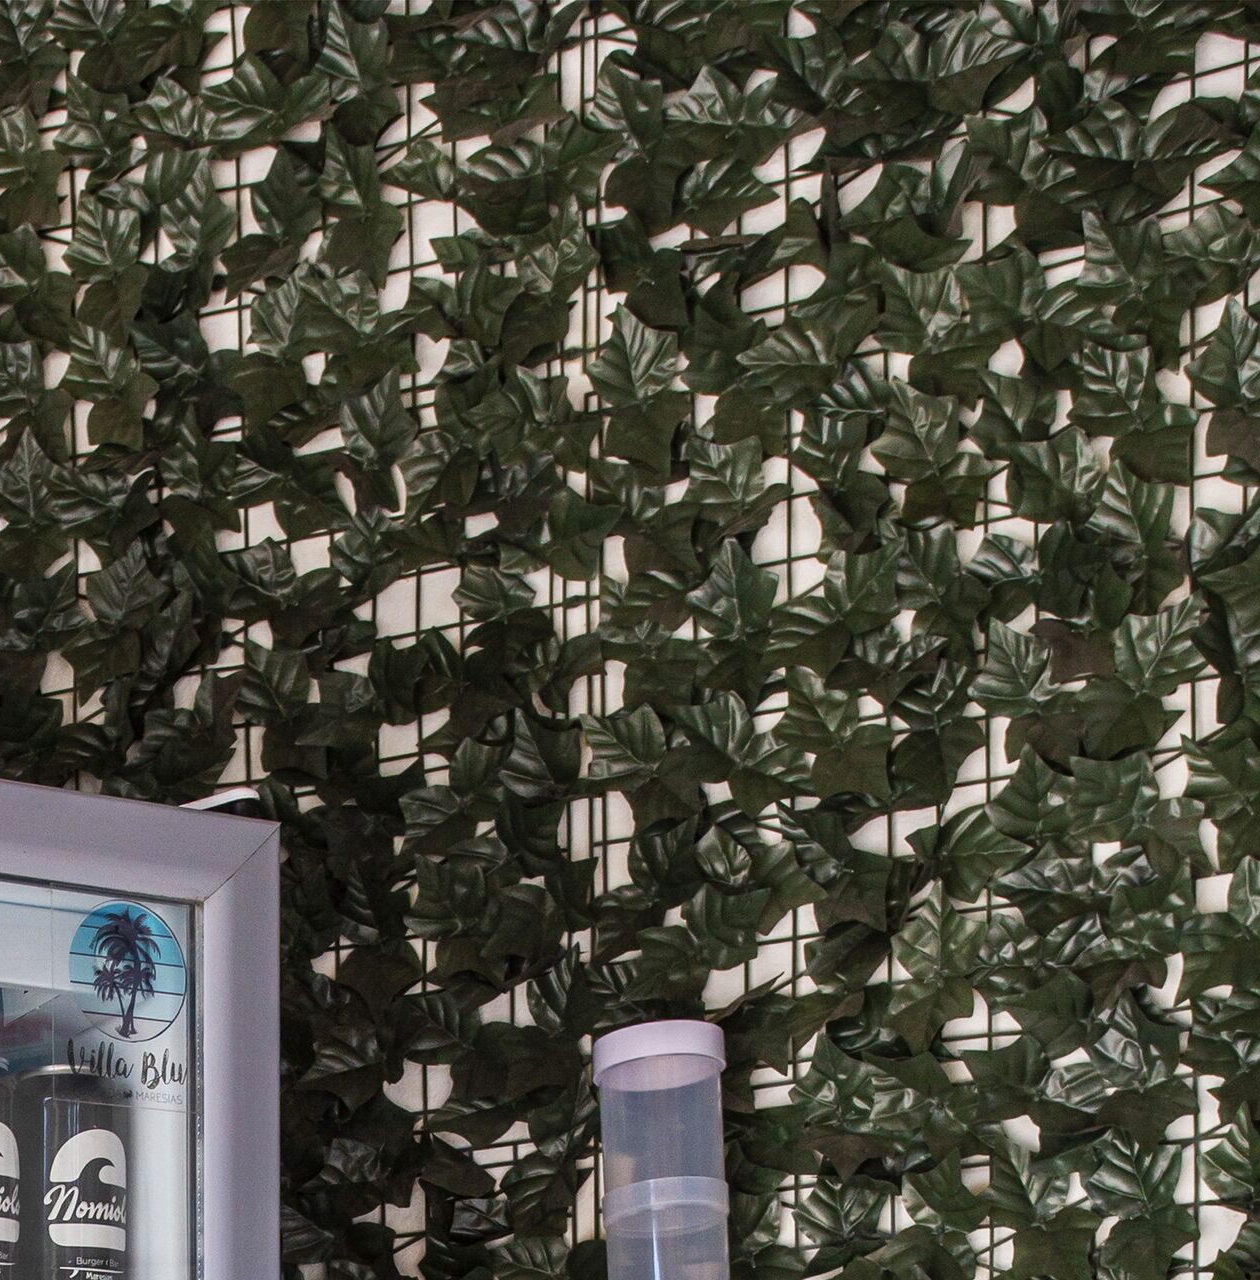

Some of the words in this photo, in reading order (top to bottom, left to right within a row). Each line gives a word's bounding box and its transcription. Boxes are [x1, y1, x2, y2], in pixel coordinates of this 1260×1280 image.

[66, 1036, 135, 1080] Villa
[140, 1048, 187, 1090] Blu
[135, 1090, 183, 1105] MARESIAS
[76, 1256, 104, 1267] Burger
